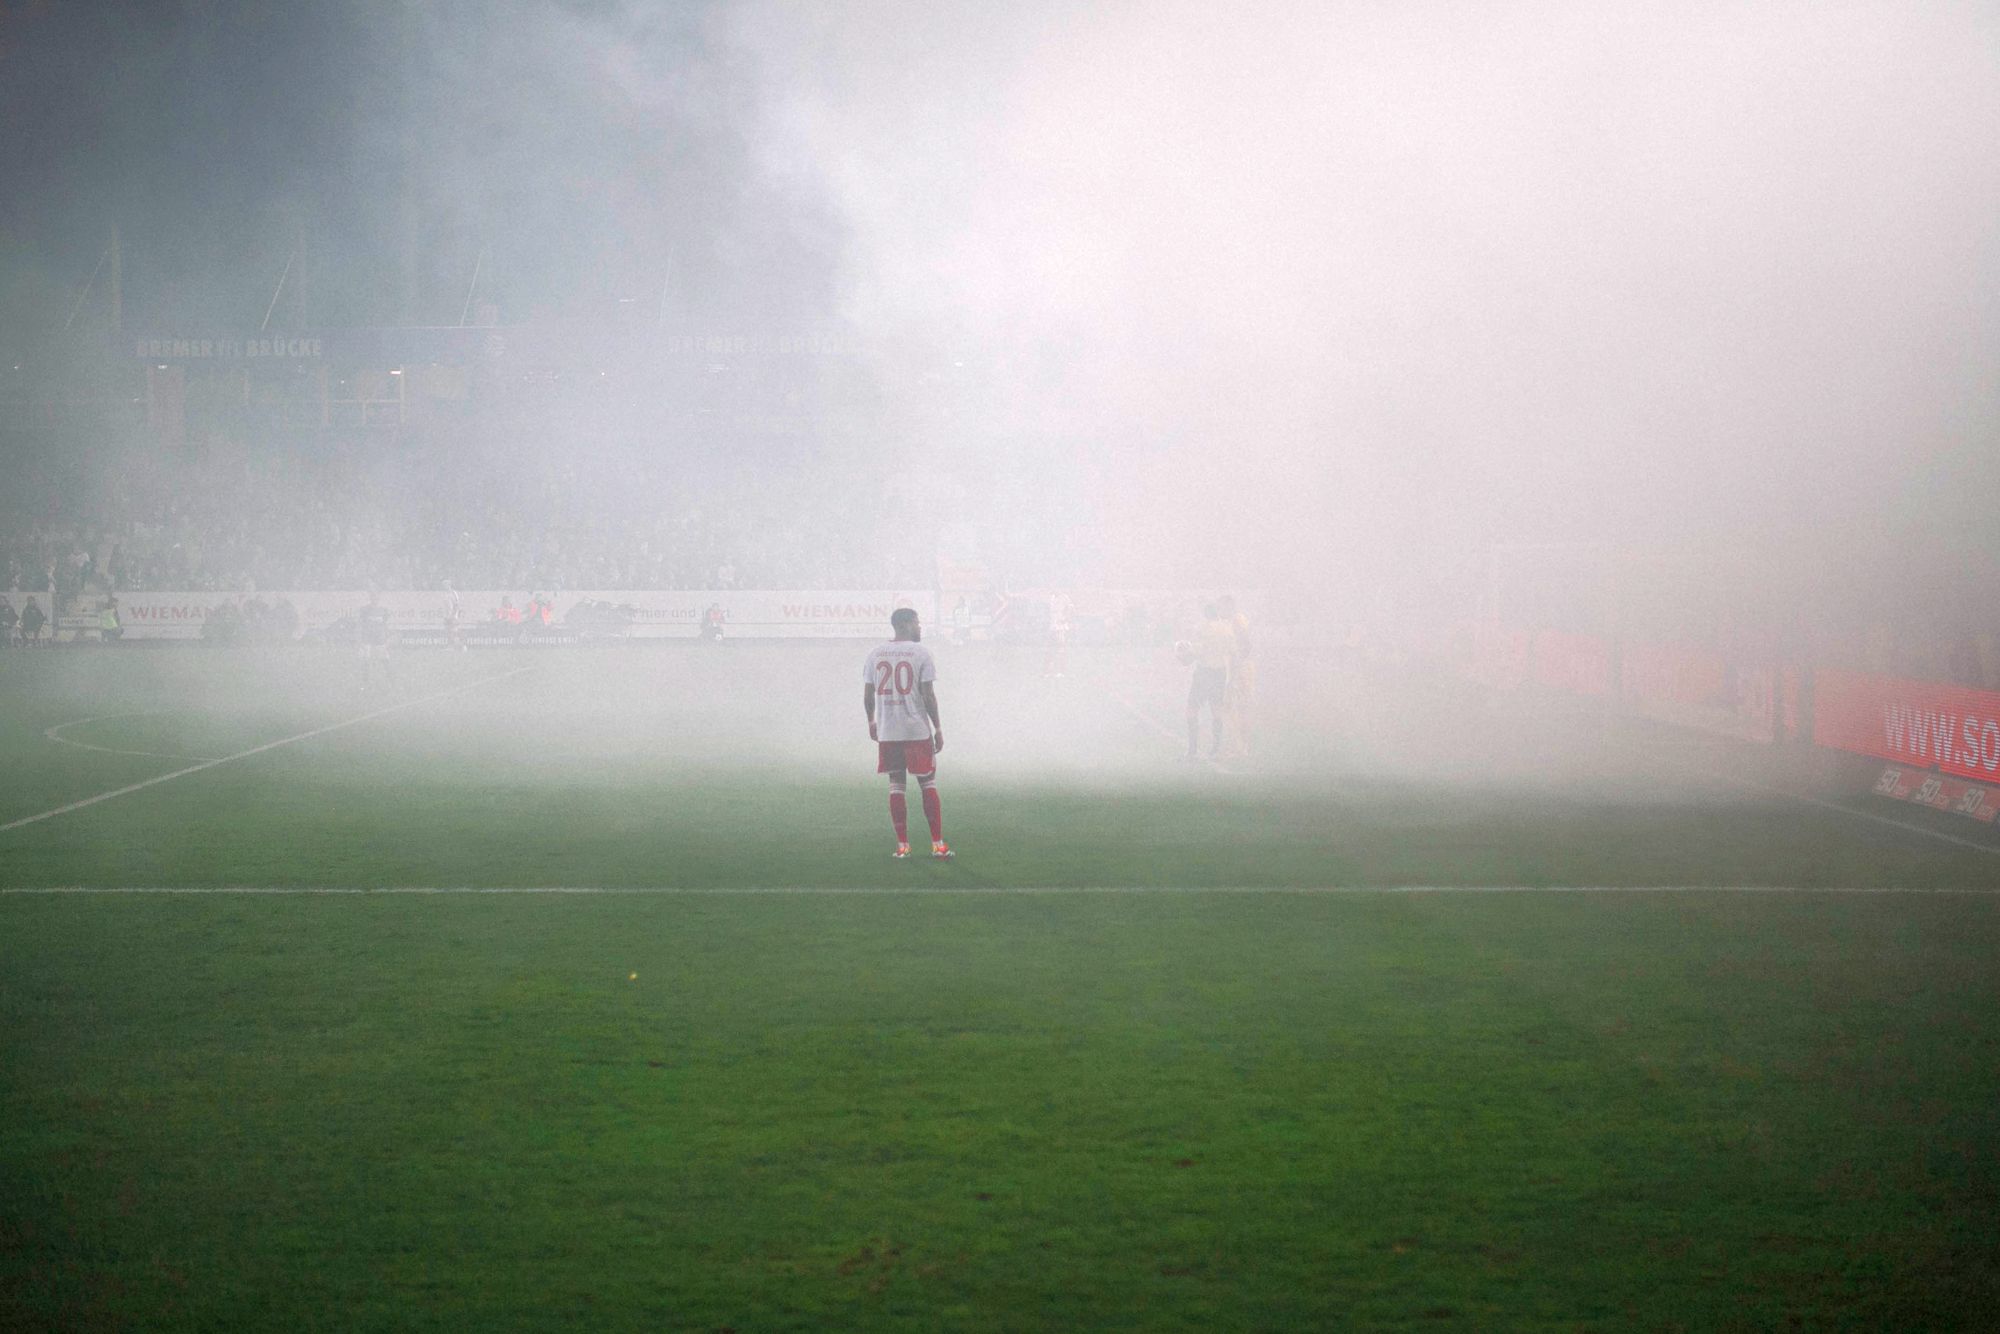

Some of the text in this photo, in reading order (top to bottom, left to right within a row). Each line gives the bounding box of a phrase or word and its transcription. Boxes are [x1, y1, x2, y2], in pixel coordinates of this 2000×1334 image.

[246, 334, 322, 357] BRÜCKE
[671, 608, 696, 618] und
[783, 605, 888, 618] WIEMANN
[876, 661, 914, 696] 20
